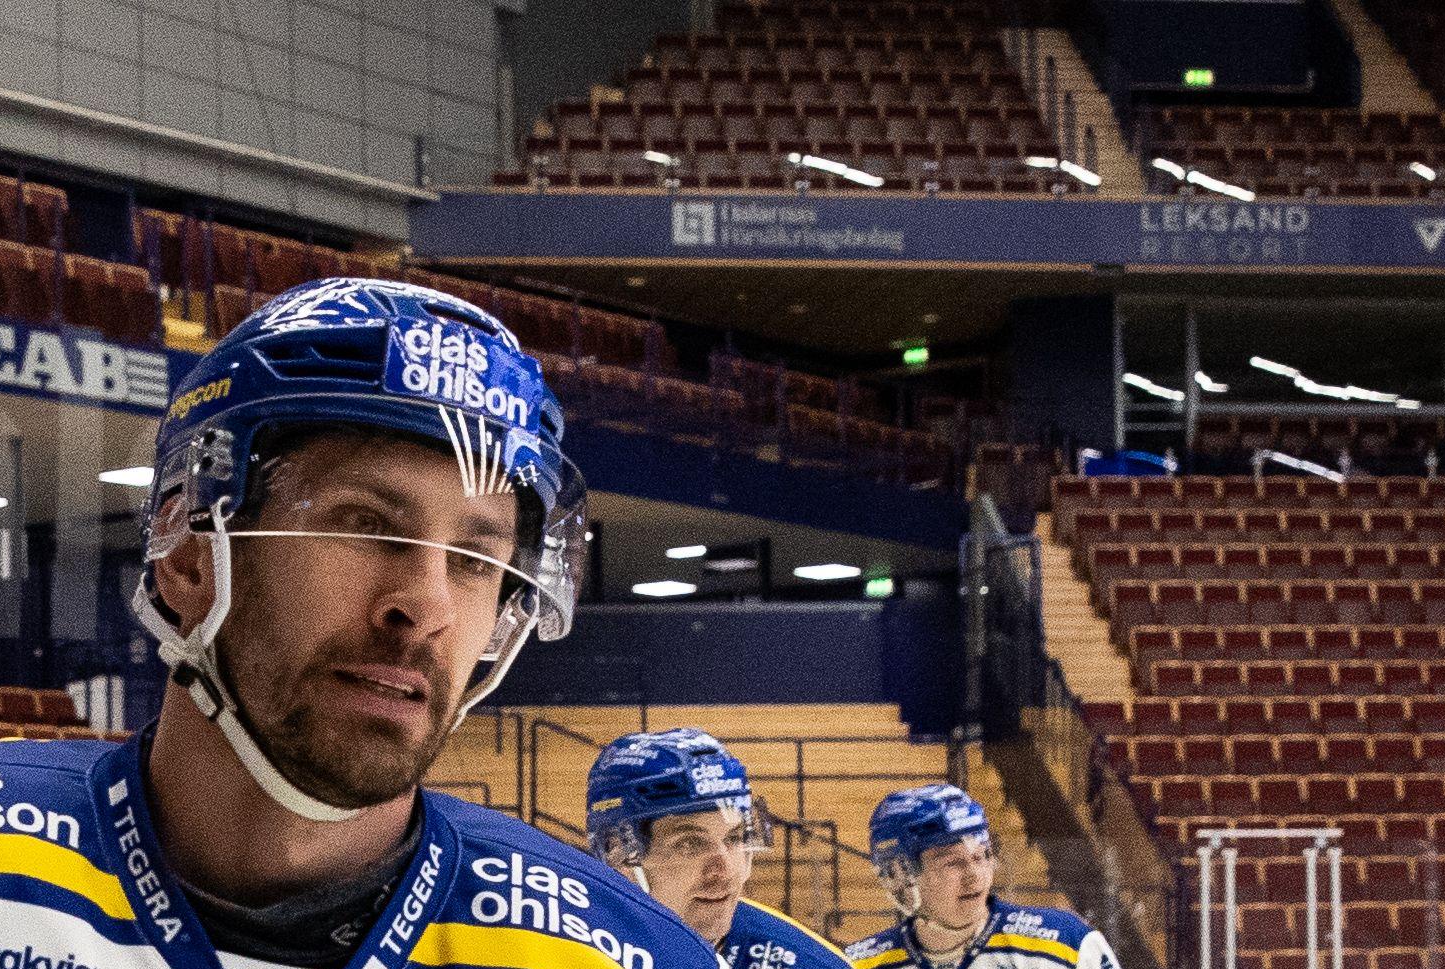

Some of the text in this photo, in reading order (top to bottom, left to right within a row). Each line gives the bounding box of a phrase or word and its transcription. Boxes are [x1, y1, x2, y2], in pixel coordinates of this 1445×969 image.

[1140, 206, 1310, 232] LEKSAND
[1140, 236, 1309, 261] RESORT
[403, 322, 488, 373] clas
[400, 361, 528, 427] ohlson
[113, 808, 184, 943] TEGERA
[379, 843, 442, 954] TEGERA
[472, 853, 590, 909] clas
[749, 941, 797, 965] clas
